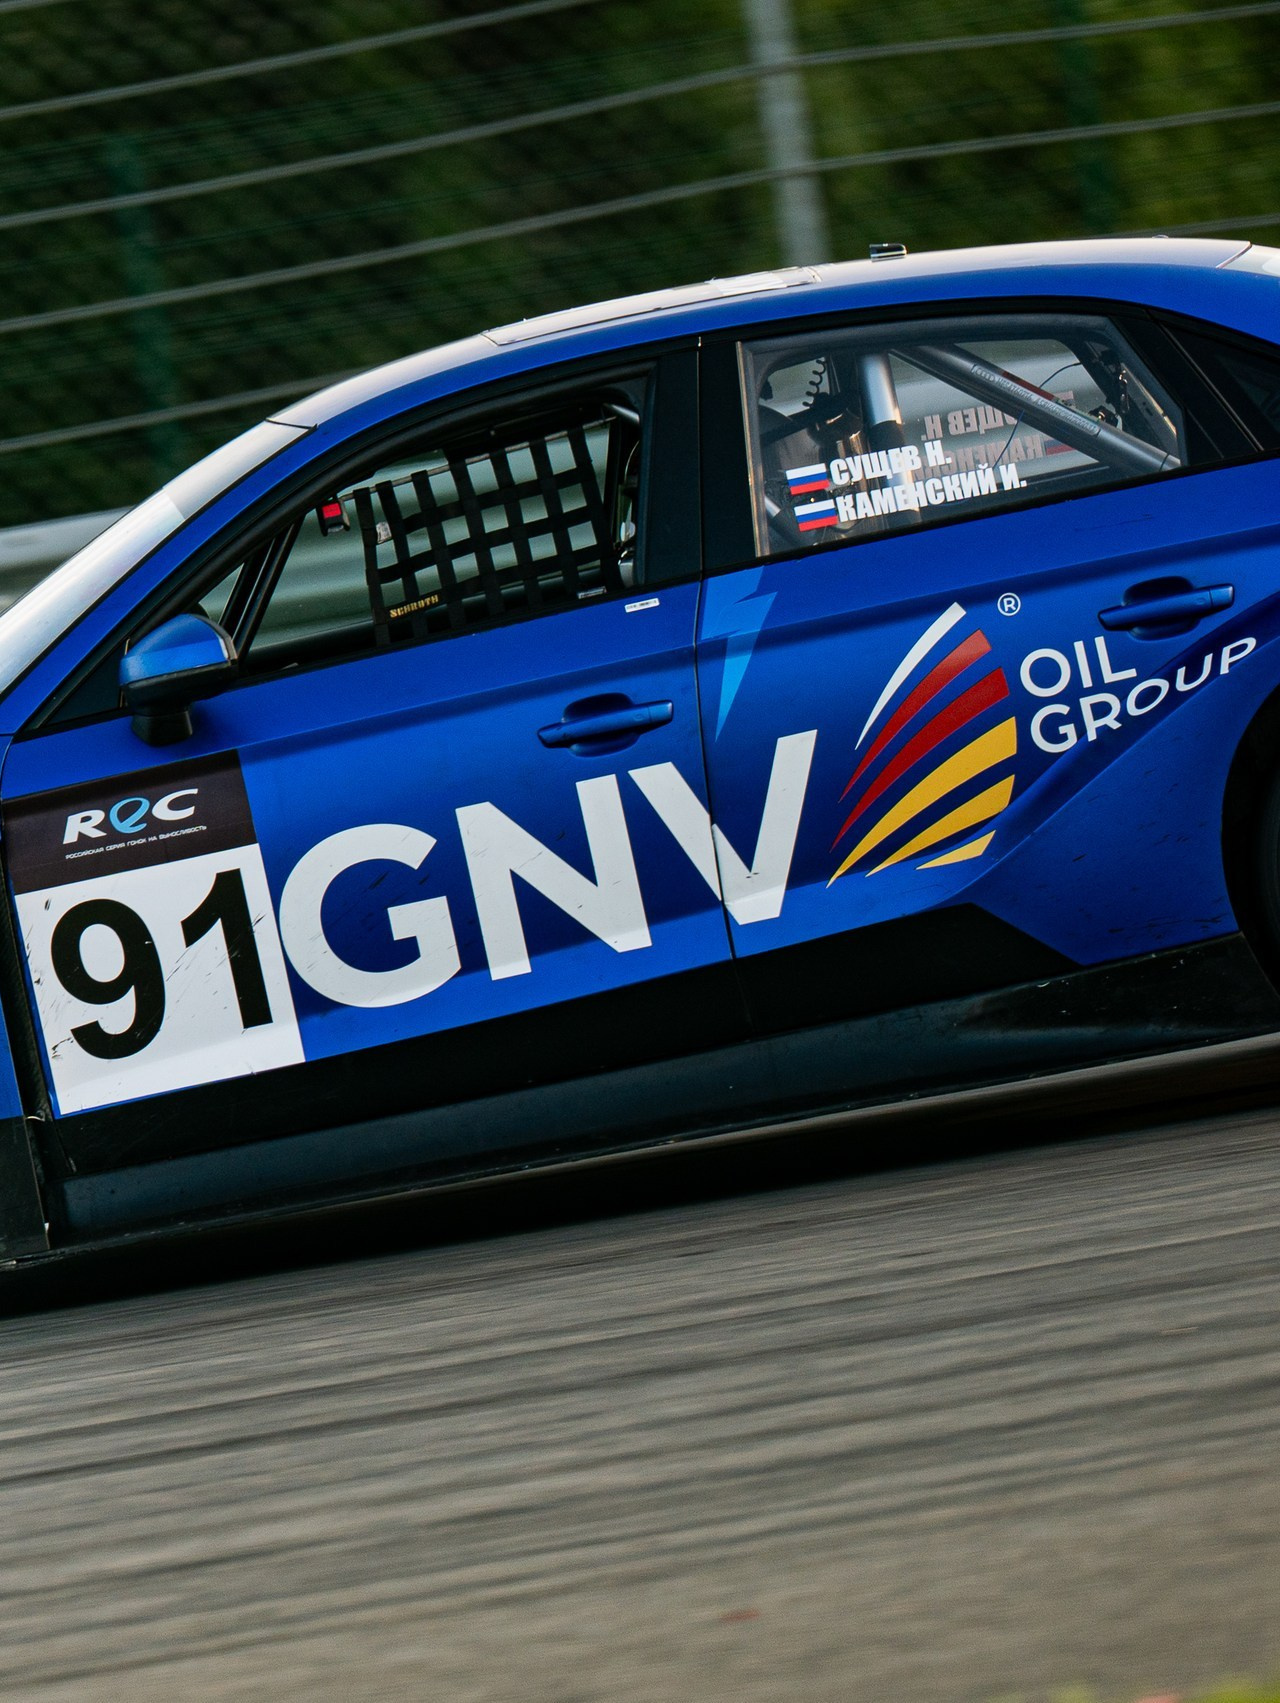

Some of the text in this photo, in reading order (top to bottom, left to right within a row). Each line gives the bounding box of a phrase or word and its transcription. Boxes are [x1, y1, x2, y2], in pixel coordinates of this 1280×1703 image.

[829, 439, 952, 486] СУЩЕВ Н.
[835, 462, 1028, 523] КАМЕНСКИЙ И.
[389, 594, 439, 618] SCHROTH
[1020, 635, 1137, 697] OIL
[1030, 636, 1257, 753] GROUP
[278, 728, 819, 1008] GNV
[50, 867, 274, 1061] 91
